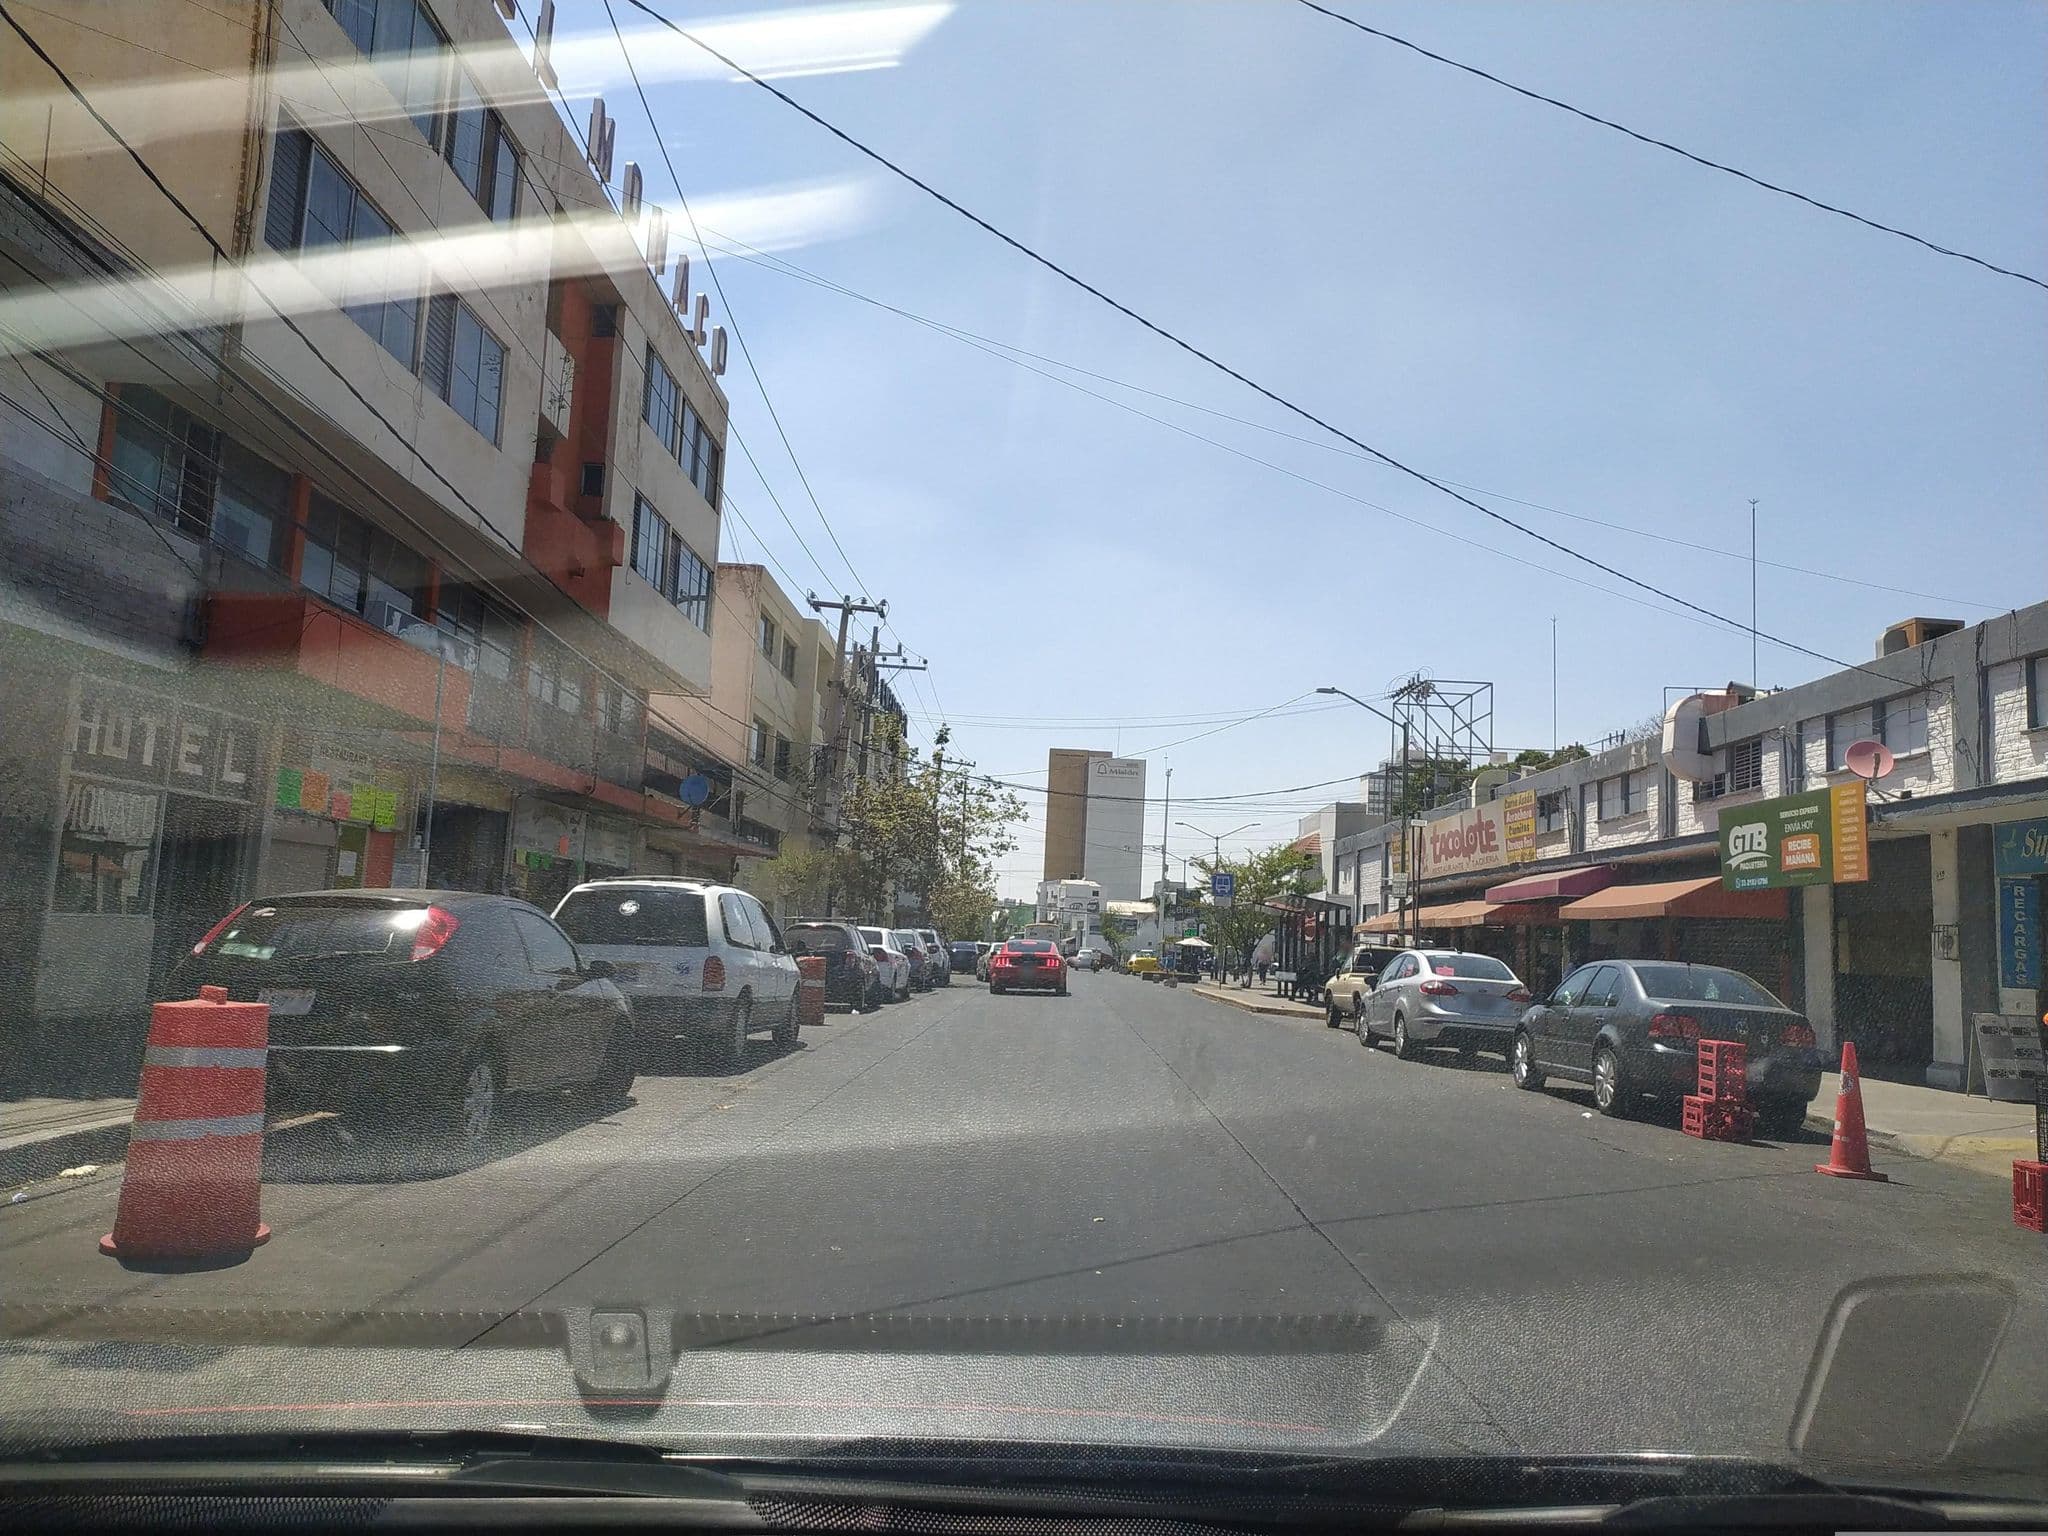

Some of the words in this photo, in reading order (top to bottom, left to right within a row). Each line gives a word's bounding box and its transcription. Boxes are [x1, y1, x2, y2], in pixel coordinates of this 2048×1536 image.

[69, 703, 246, 785] HOTEL
[1800, 819, 1814, 831] HOY
[1729, 823, 1767, 855] GTB
[1787, 838, 1812, 851] RECIBE
[1785, 851, 1815, 866] MAÑANA
[2014, 886, 2027, 985] RECARGAS
